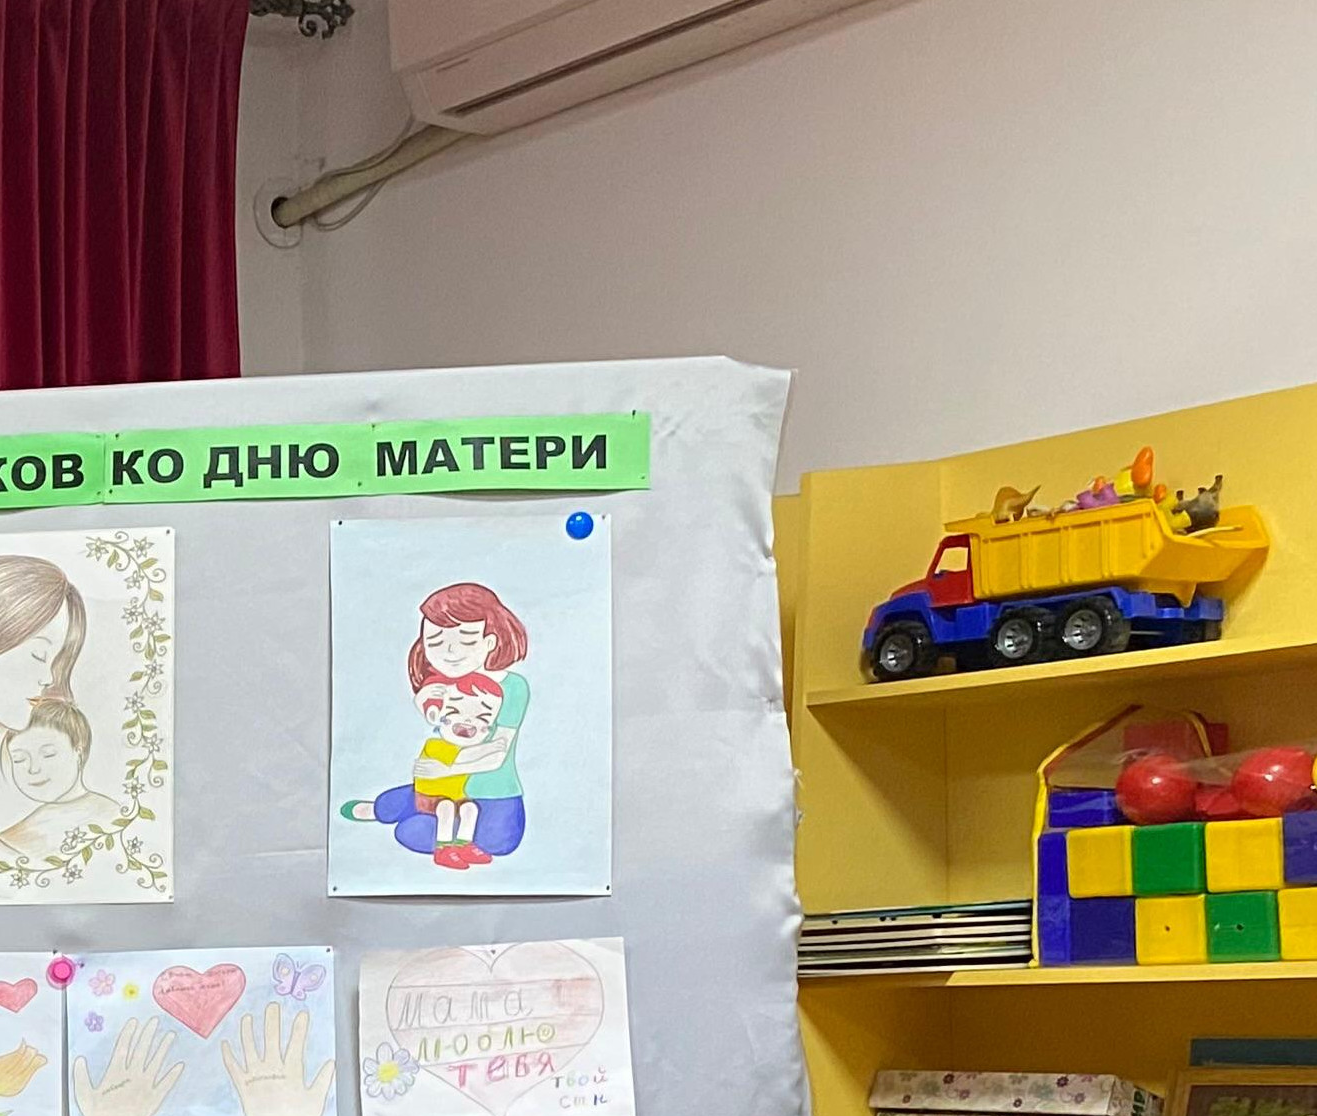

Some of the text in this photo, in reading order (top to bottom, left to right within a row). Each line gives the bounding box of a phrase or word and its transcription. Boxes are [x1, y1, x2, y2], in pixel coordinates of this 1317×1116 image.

[111, 447, 185, 487] КО
[202, 443, 340, 489] ДНЮ
[374, 434, 608, 477] МАТЕРИ
